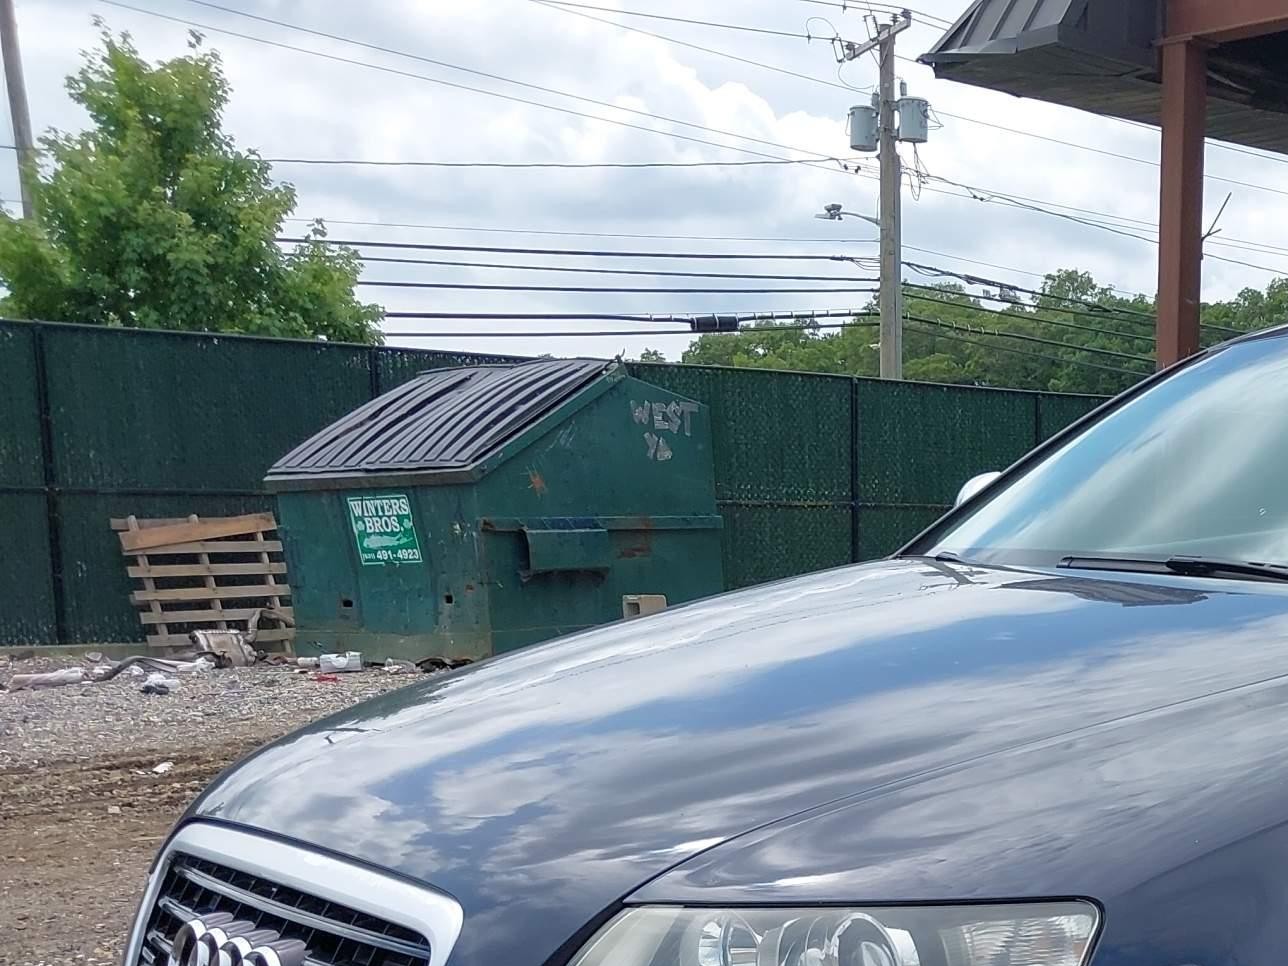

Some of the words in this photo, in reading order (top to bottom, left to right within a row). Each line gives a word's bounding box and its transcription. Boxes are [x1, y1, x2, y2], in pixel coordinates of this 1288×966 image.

[629, 400, 699, 436] WEST
[351, 499, 409, 516] WINTERS
[364, 516, 404, 533] BROS.
[376, 548, 419, 560] 491-4923
